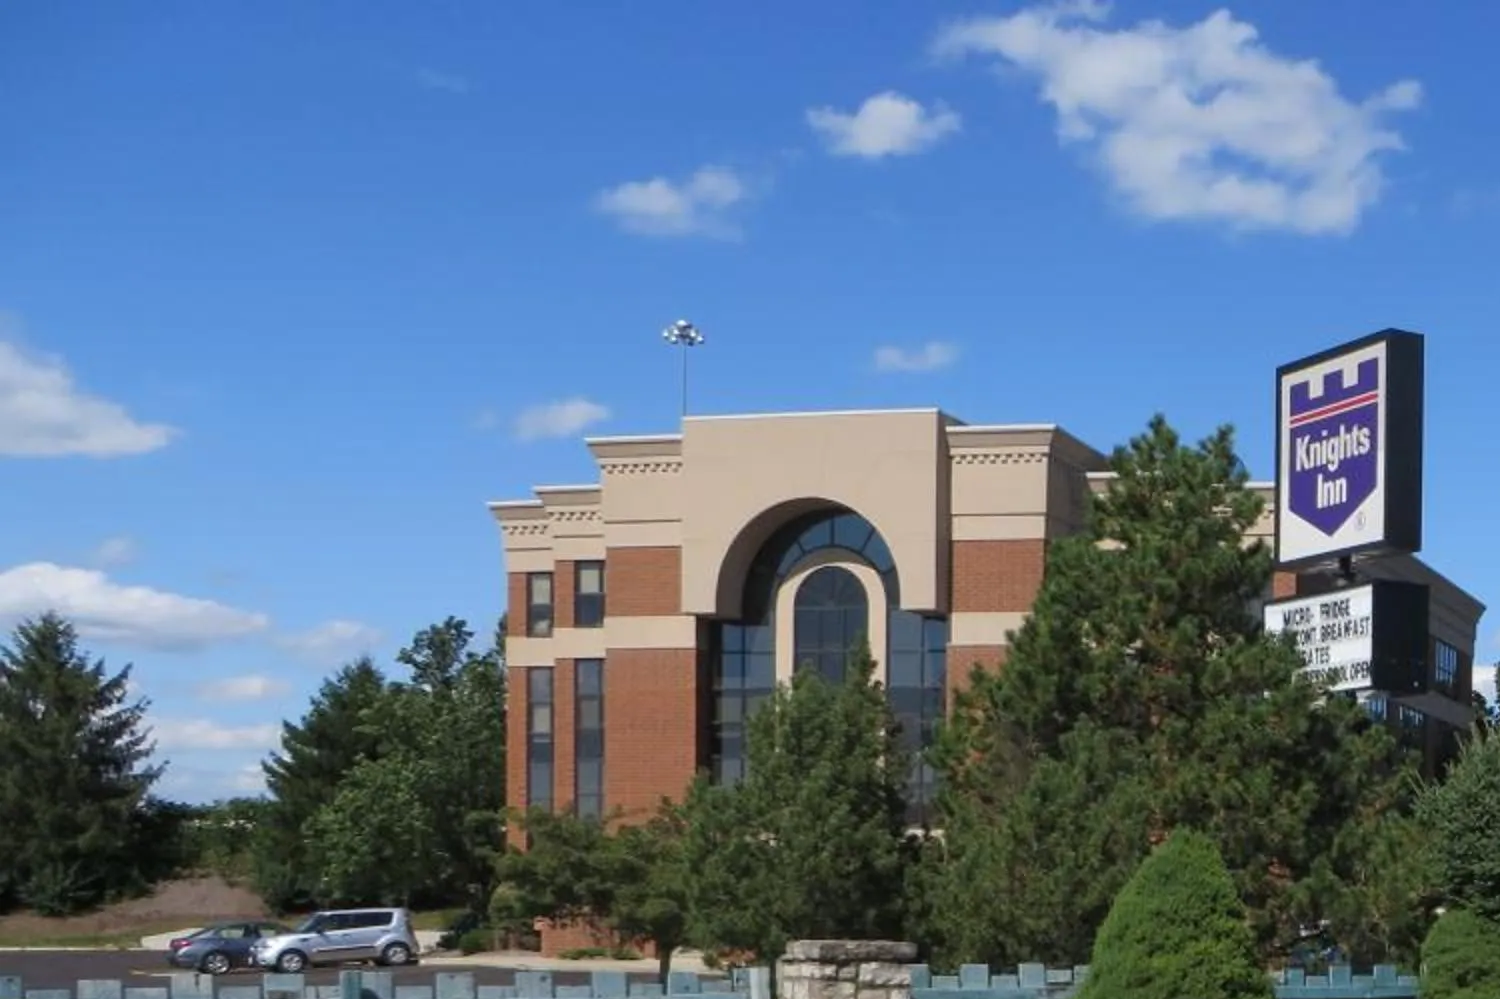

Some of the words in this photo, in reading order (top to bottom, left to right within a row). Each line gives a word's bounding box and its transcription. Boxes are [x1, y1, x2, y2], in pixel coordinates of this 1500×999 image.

[1296, 423, 1371, 472] Knights
[1317, 473, 1347, 509] Inn
[1320, 598, 1350, 620] FRIDGE
[1321, 616, 1370, 642] BREAKFAST
